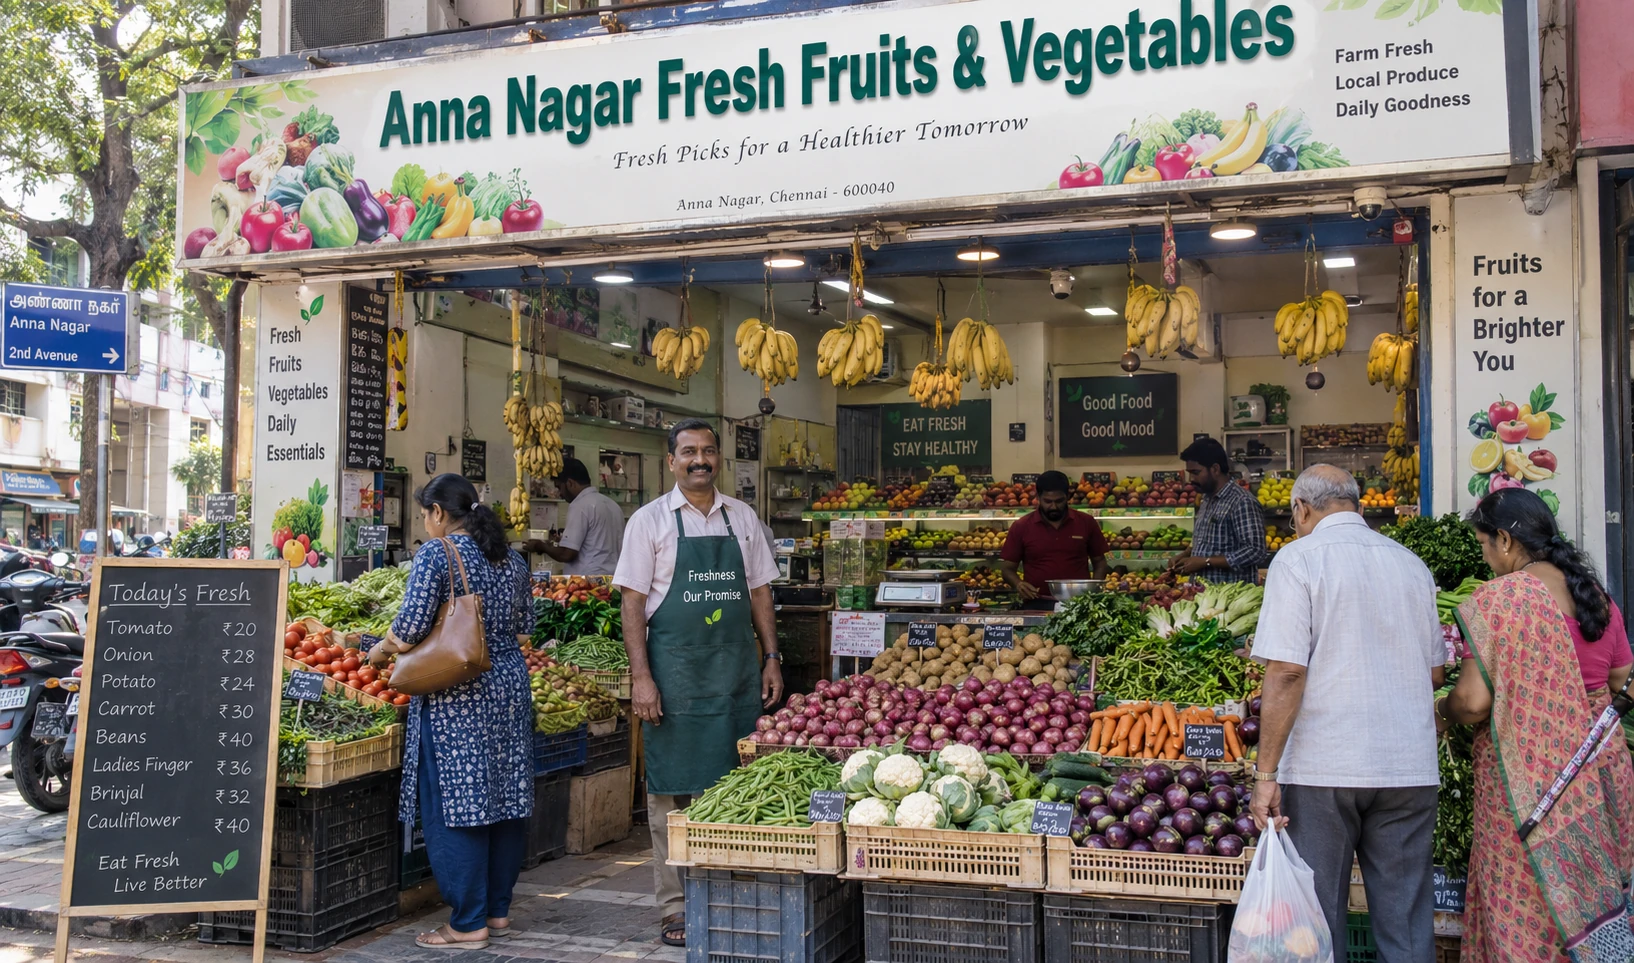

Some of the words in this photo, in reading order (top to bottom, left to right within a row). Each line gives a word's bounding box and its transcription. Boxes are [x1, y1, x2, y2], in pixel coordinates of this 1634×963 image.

[1336, 48, 1379, 63] Farm
[1385, 39, 1433, 58] Fresh
[379, 90, 491, 148] Anna
[507, 75, 642, 147] Nagar
[658, 48, 785, 122] Fresh
[802, 33, 938, 106] Fruits
[953, 25, 986, 91] &
[1000, 1, 1295, 97] Vegetables
[1336, 71, 1380, 90] Local
[1387, 66, 1459, 85] Produce
[1336, 99, 1379, 118] Daily
[1385, 94, 1471, 112] Goodness
[613, 144, 666, 169] Fresh
[677, 142, 729, 163] Picks
[734, 139, 769, 165] for
[778, 141, 788, 153] a
[800, 125, 906, 151] Healthier
[916, 118, 1028, 140] Tomorrow
[677, 199, 712, 211] Anna
[719, 195, 764, 209] Nagar,
[770, 187, 827, 203] Chennai
[843, 181, 894, 197] 600040
[1474, 252, 1542, 276] Fruits
[10, 291, 83, 311] அண்ணா
[88, 297, 120, 315] நகர்
[1473, 286, 1506, 308] for
[1514, 290, 1528, 306] a
[10, 316, 45, 330] Anna
[50, 318, 91, 335] Nagar
[270, 325, 301, 344] Fresh
[1474, 316, 1565, 344] Brighter
[9, 346, 31, 359] 2nd
[34, 348, 78, 362] Avenue
[1473, 350, 1514, 371] You
[269, 355, 302, 373] Fruits
[268, 382, 328, 406] Vegetables
[1083, 393, 1116, 411] Good
[1121, 392, 1152, 409] Food
[268, 414, 297, 436] Daily
[903, 417, 925, 432] EAT
[928, 416, 966, 431] FRESH
[1082, 421, 1114, 437] Good
[1119, 419, 1154, 436] Mood
[267, 442, 325, 461] Essentials
[893, 442, 921, 456] STAY
[925, 440, 978, 455] HEALTHY
[689, 569, 735, 582] Freshness
[109, 582, 187, 608] Today's
[197, 582, 251, 601] Fresh
[683, 590, 702, 602] Our
[704, 589, 741, 601] Promise
[107, 620, 173, 635] Tomato
[223, 622, 256, 636] ₹20
[104, 647, 153, 661] Onion
[222, 649, 255, 664] ₹28
[102, 674, 156, 688] Potato
[220, 677, 255, 691] ₹24
[99, 701, 155, 716] Carrot
[219, 704, 254, 719] ₹30
[96, 729, 146, 744] Beans
[218, 732, 252, 747] ₹40
[93, 756, 140, 772] Ladies
[145, 757, 193, 777] Finger
[217, 760, 252, 775] ₹36
[91, 783, 144, 805] Brinjal
[216, 789, 250, 804] ₹32
[87, 812, 181, 829] Cauliflower
[215, 818, 250, 833] ₹40
[99, 855, 128, 870] Eat
[135, 851, 179, 869] Fresh
[114, 878, 146, 892] Live
[154, 876, 207, 891] Better
